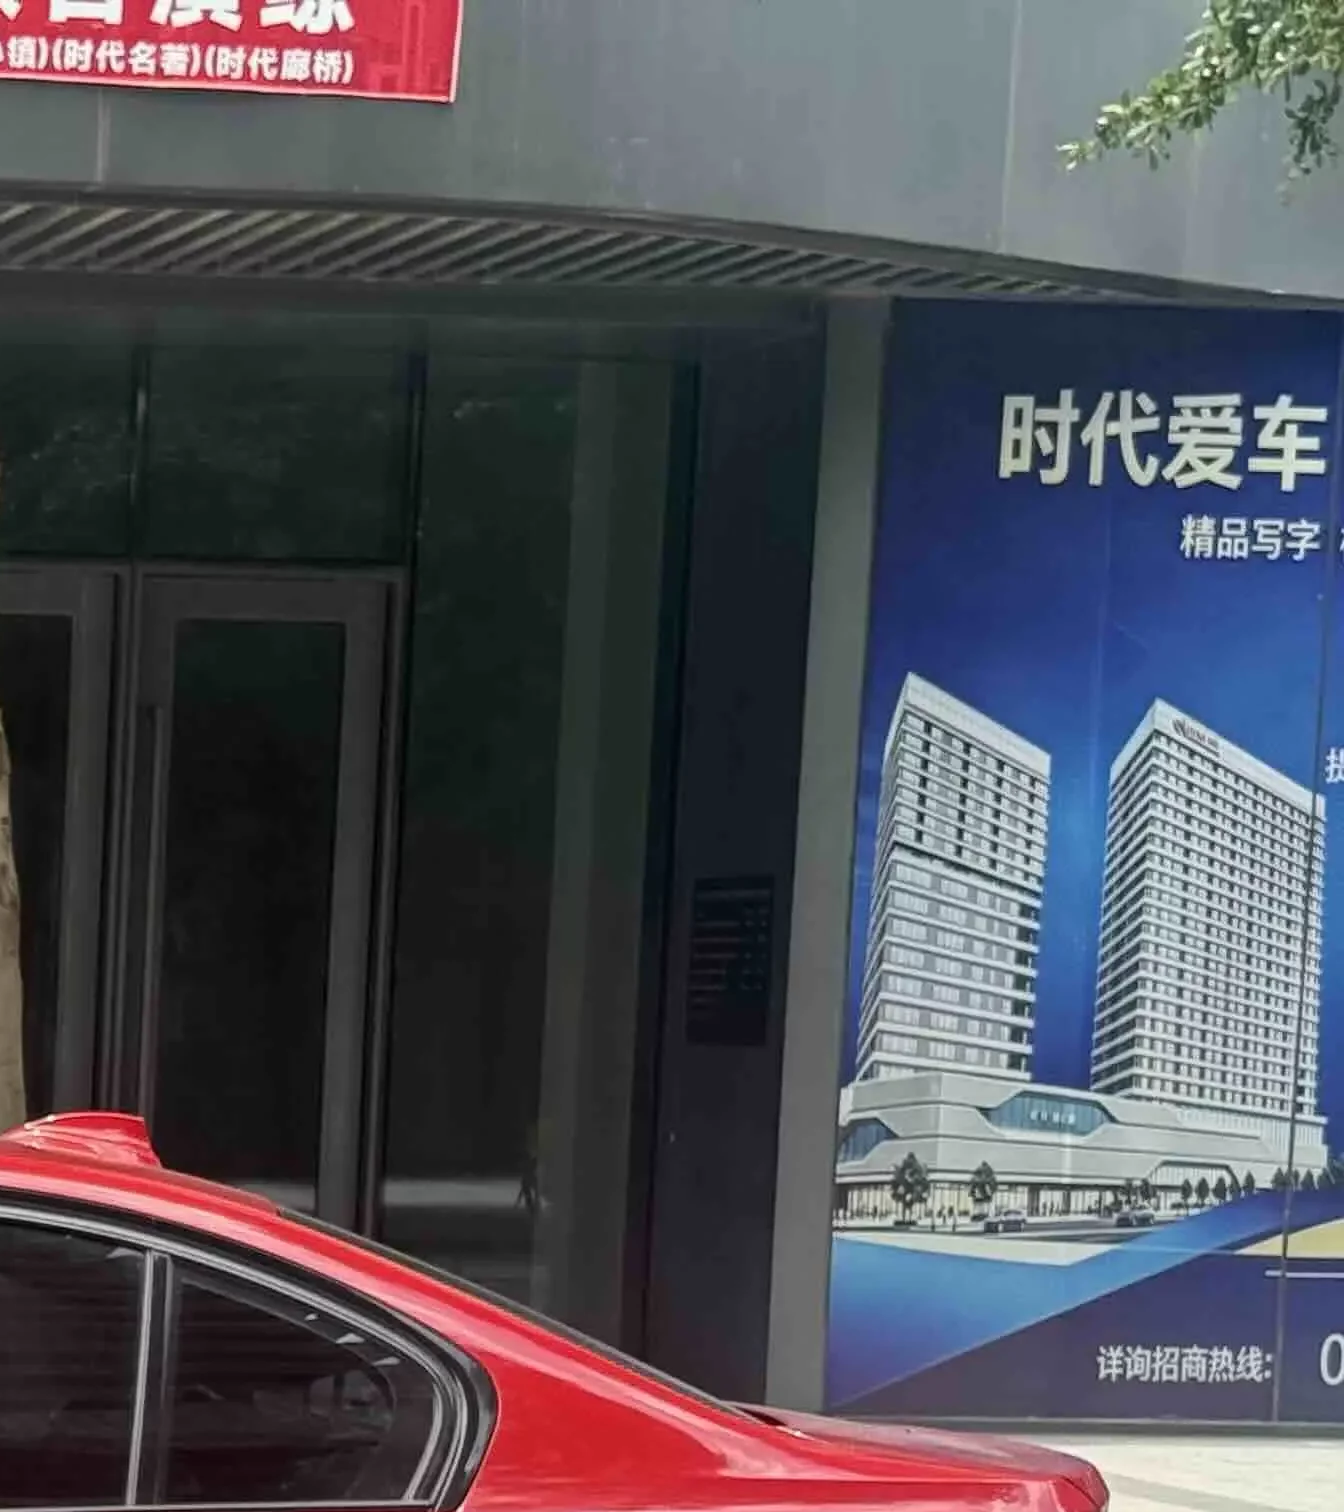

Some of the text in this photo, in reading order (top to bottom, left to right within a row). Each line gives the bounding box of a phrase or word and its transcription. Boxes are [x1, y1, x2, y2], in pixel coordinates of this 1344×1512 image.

[999, 389, 1328, 492] 时代爱车
[1180, 513, 1344, 562] 精品写字
